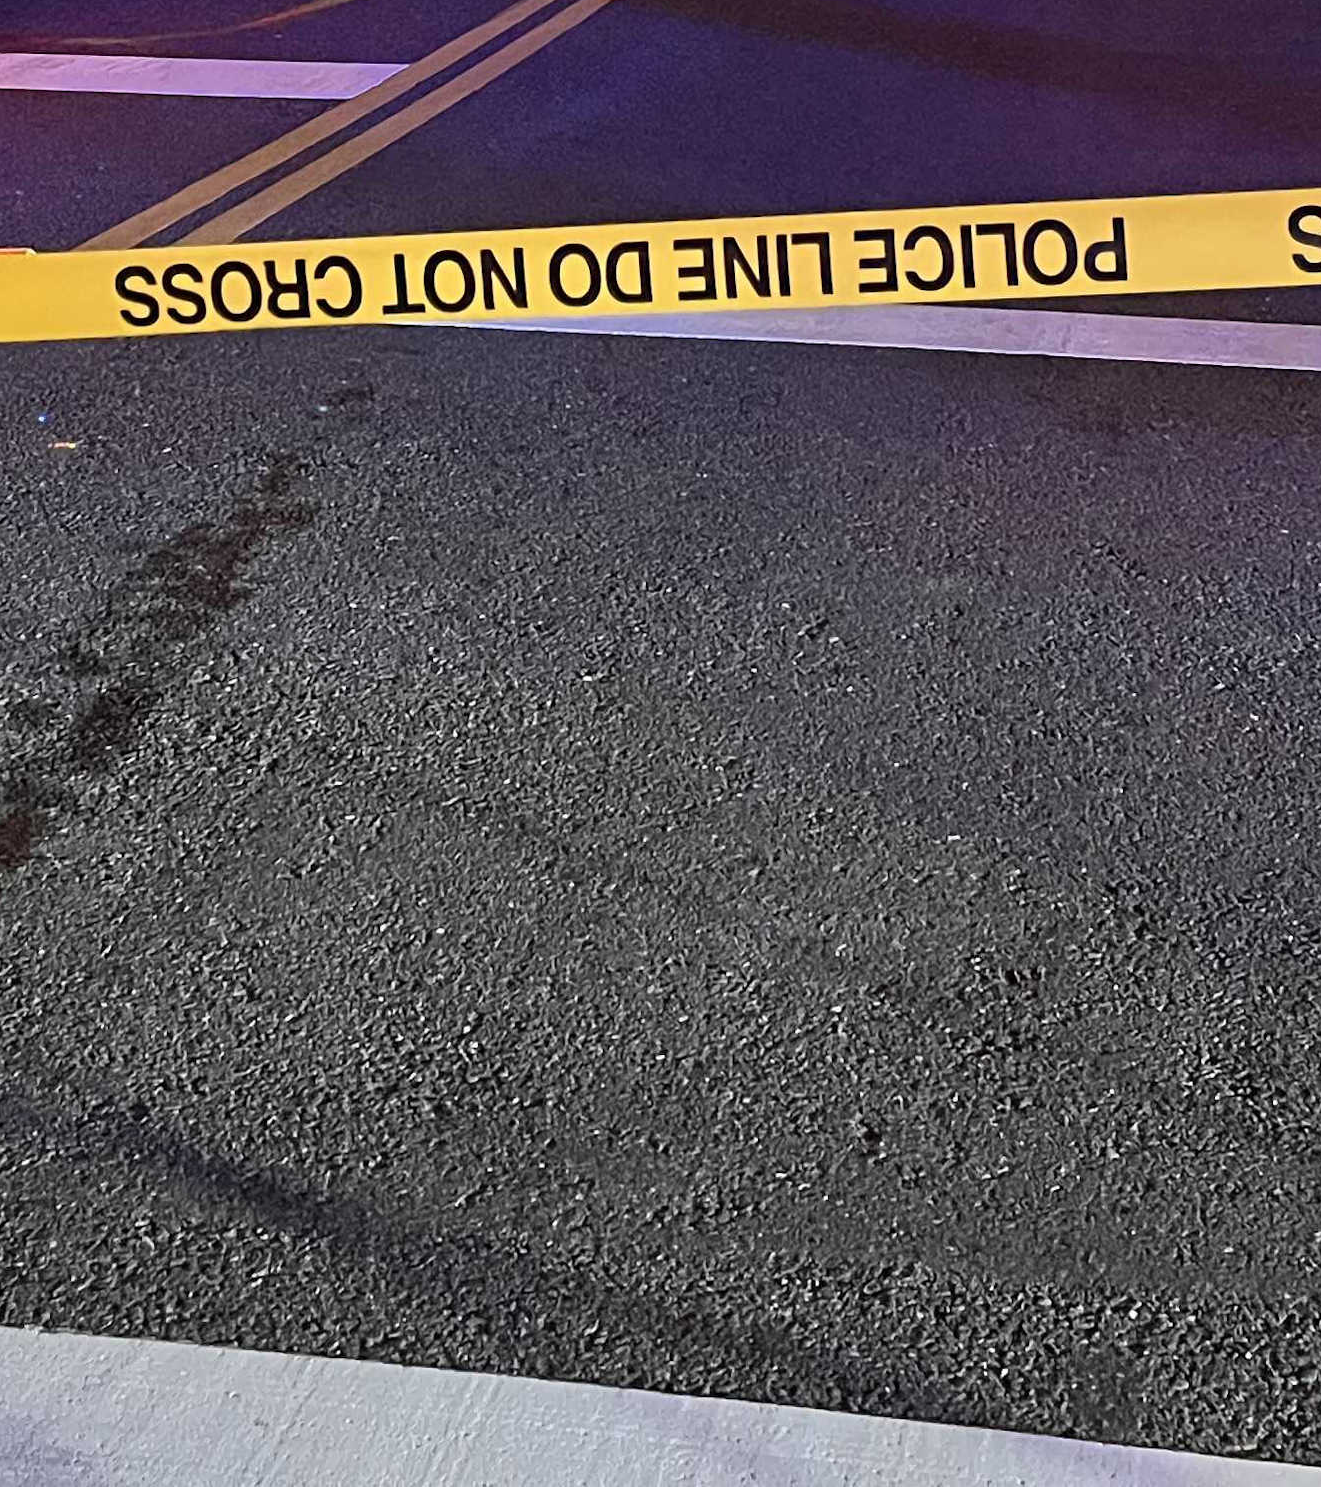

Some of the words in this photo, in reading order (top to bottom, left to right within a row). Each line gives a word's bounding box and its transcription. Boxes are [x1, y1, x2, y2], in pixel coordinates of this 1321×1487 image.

[383, 248, 527, 314] NOT
[549, 241, 652, 306] DO
[674, 232, 833, 300] LINE
[854, 217, 1127, 293] POLICE
[116, 256, 362, 326] CROSS
